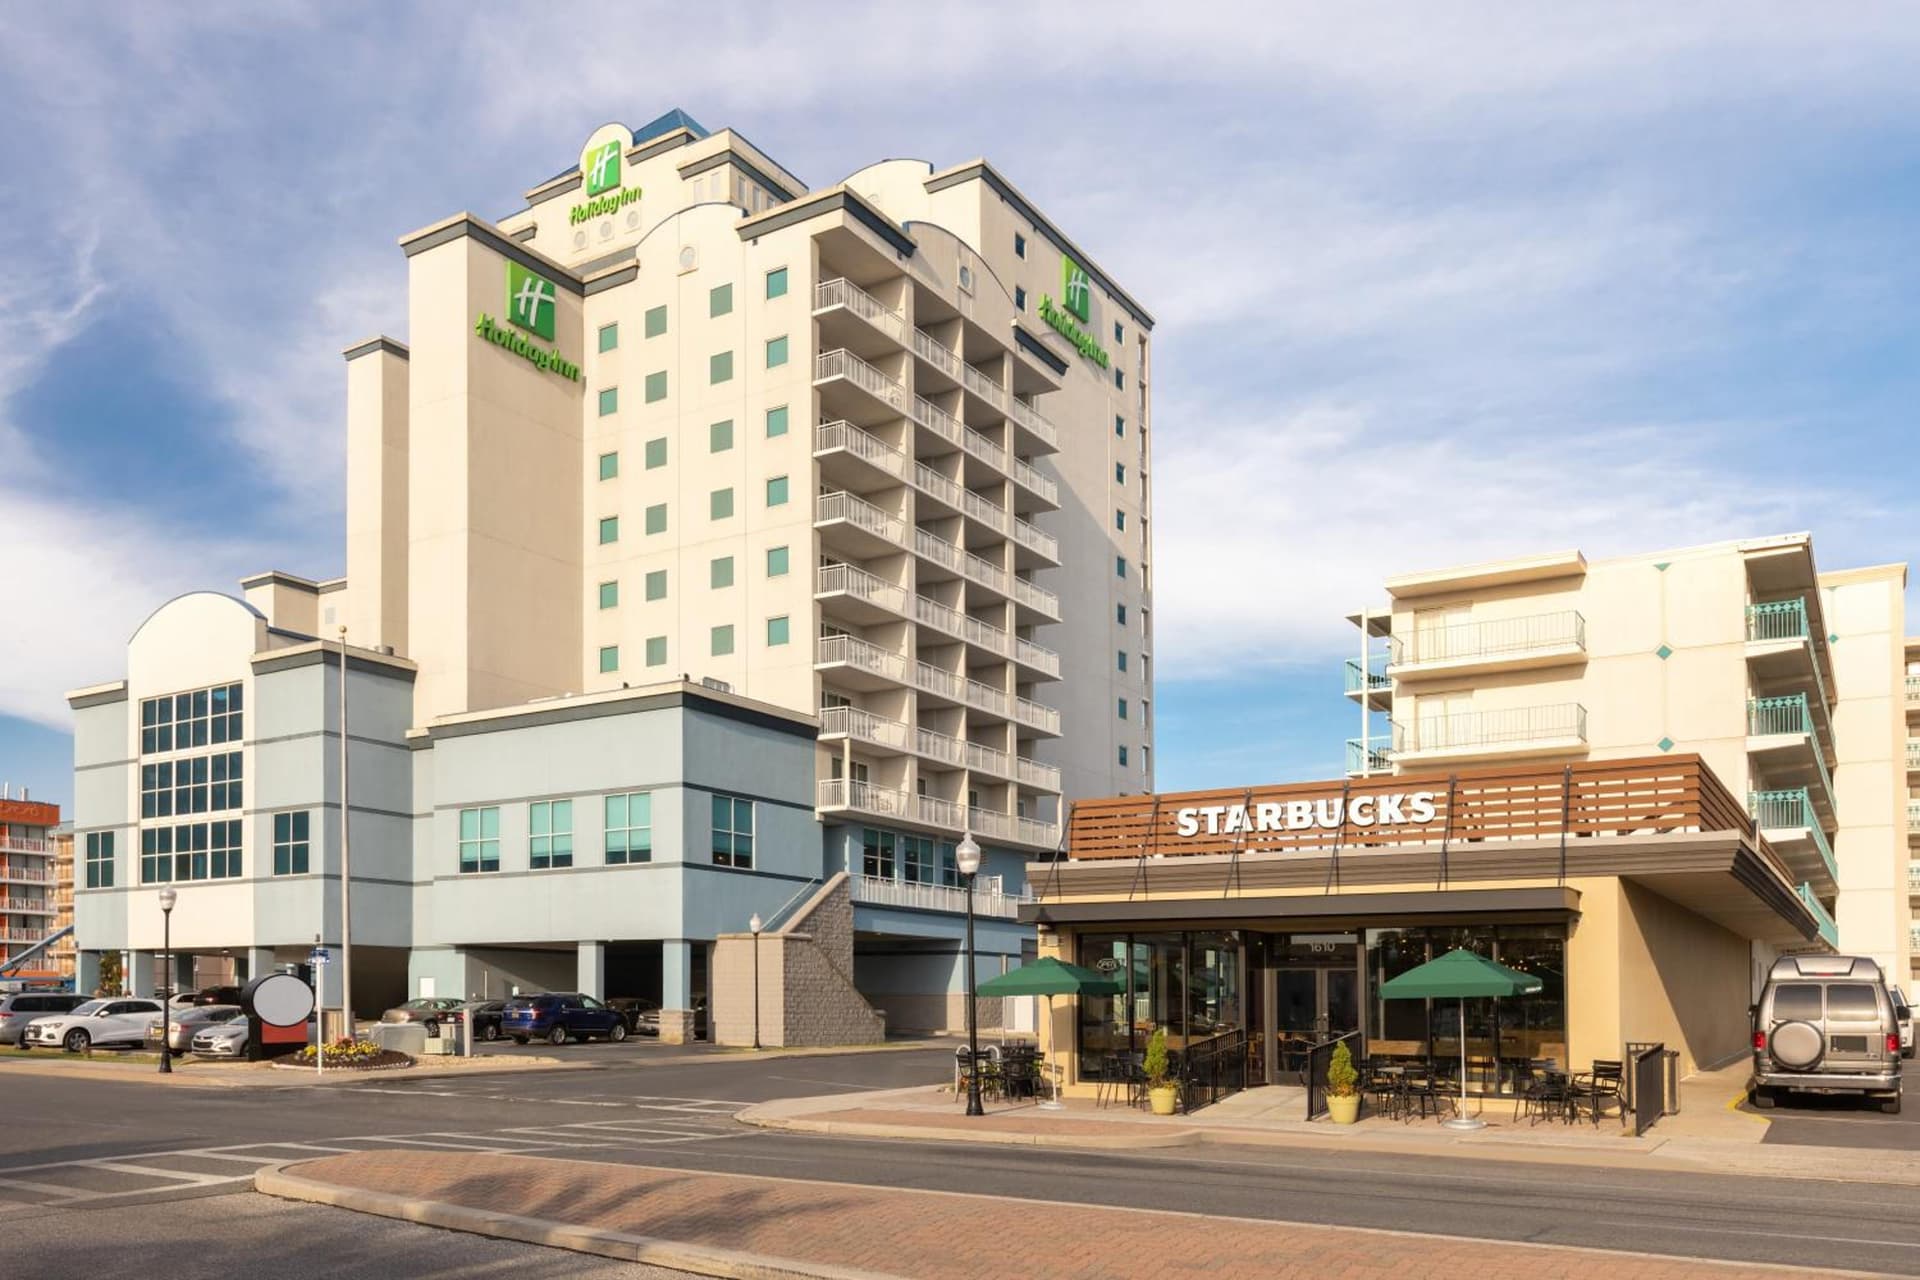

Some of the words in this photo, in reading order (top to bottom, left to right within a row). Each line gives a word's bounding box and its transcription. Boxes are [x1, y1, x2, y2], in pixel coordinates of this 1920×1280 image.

[569, 196, 620, 226] Holiday
[620, 186, 642, 207] Inn
[475, 312, 549, 373] Holiday
[549, 347, 579, 382] Inn
[1038, 292, 1088, 359] Holiday
[1087, 333, 1109, 369] Inn
[1177, 791, 1437, 837] STARBUCKS
